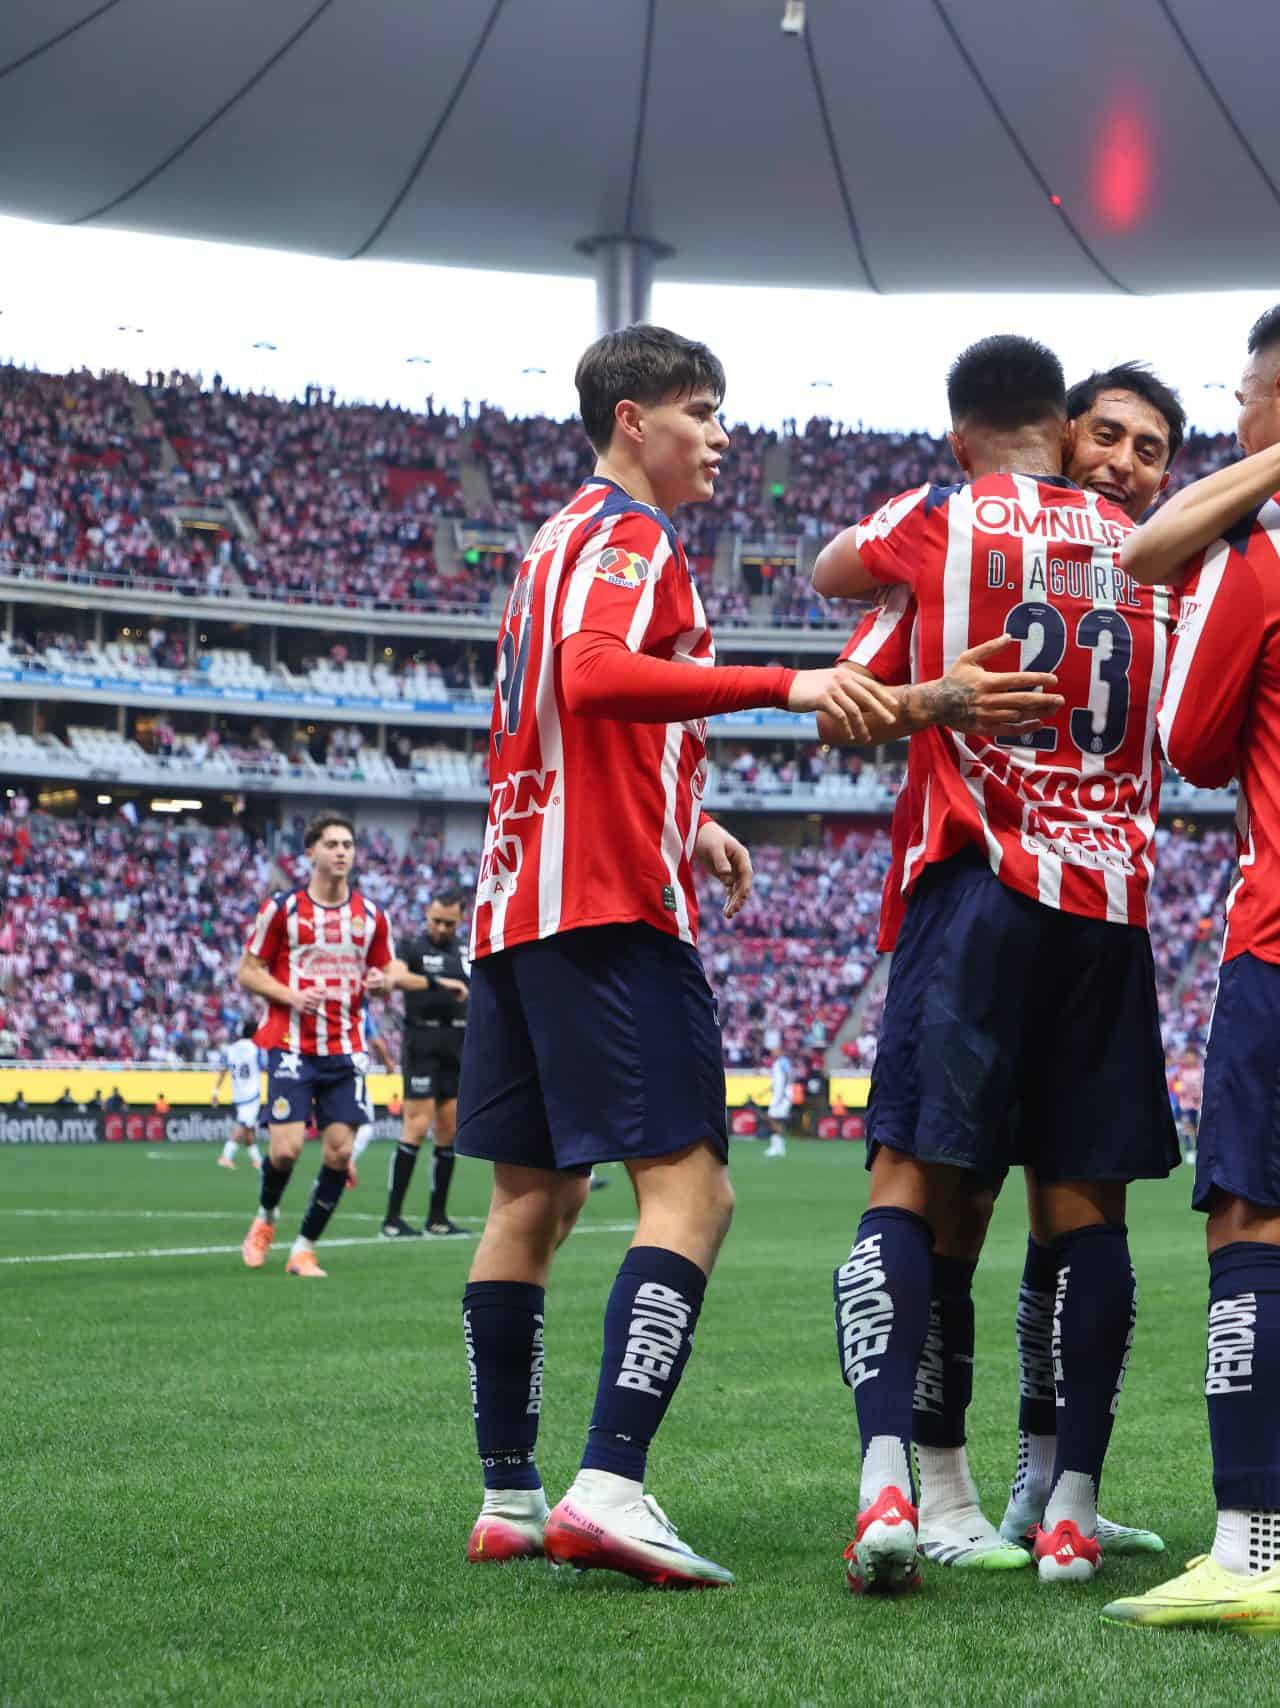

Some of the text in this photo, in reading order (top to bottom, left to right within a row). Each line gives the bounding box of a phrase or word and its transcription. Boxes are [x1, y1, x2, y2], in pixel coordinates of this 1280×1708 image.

[975, 499, 1135, 548] OMNILIF
[988, 550, 1015, 590] D.
[994, 601, 1133, 757] 23
[838, 1233, 895, 1391] PERDURA
[1205, 1292, 1258, 1397] PERDUR
